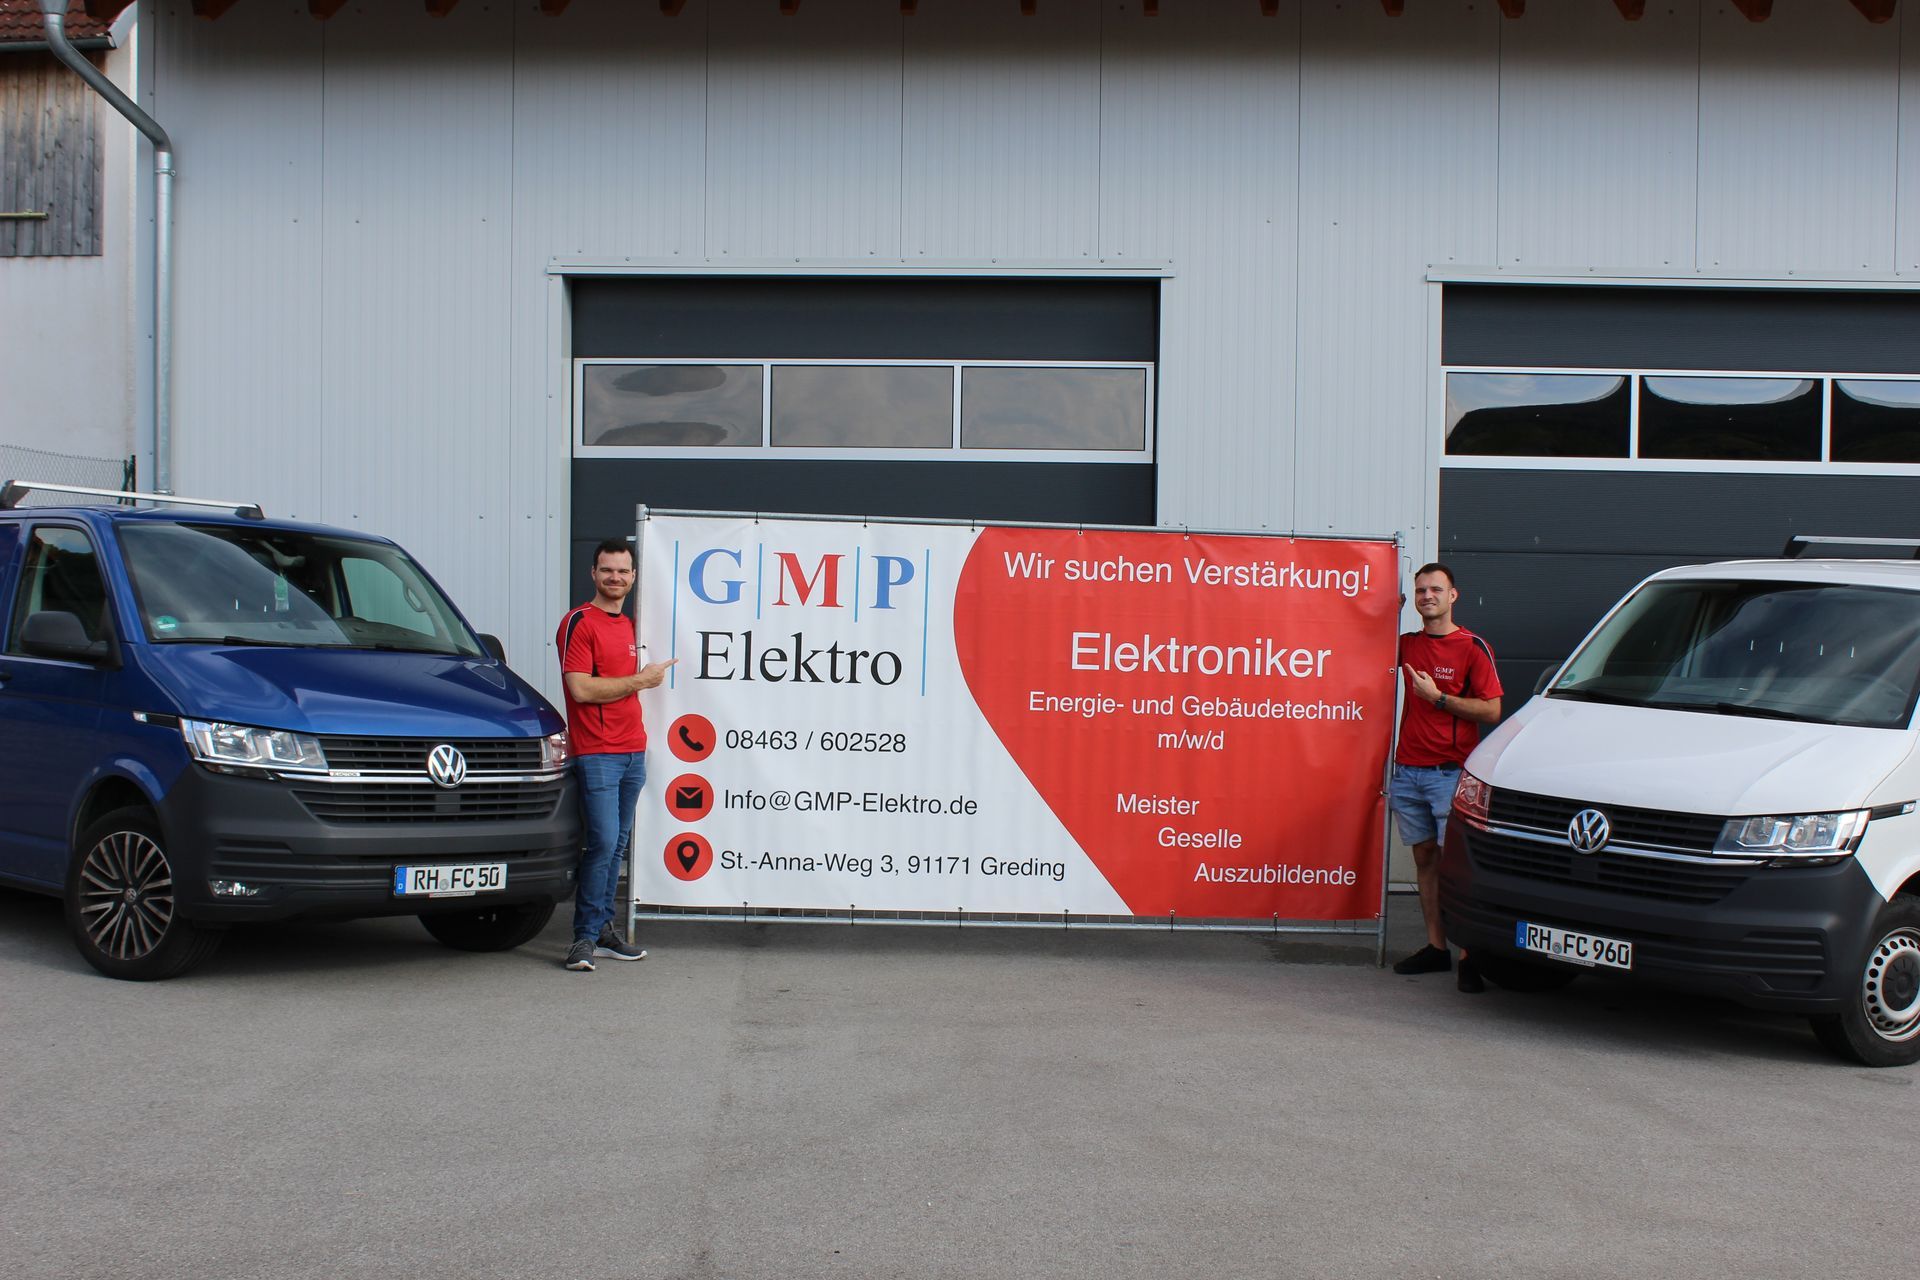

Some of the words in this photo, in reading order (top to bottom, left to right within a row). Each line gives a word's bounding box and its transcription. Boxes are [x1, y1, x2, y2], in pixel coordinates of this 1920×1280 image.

[1003, 551, 1056, 579] Wir
[1064, 555, 1172, 583] suchen
[1183, 557, 1370, 597] Verstärkung!
[694, 630, 902, 686] Elektro
[1071, 631, 1332, 678] Elektroniker
[1029, 690, 1125, 718] Energie-
[1132, 695, 1174, 716] und
[1181, 695, 1363, 721] Gebäudetechnik
[725, 729, 798, 751] 08463
[805, 730, 814, 750] /
[820, 731, 906, 753] 602528
[1157, 730, 1225, 750] m/w/d
[725, 789, 978, 816] Info@GMP-Elektro.de
[1116, 793, 1200, 816] Meister
[1158, 826, 1242, 849] Geselle
[414, 869, 439, 890] RH
[451, 868, 474, 888] FC
[478, 866, 500, 888] 50
[720, 850, 873, 878] St.-Anna-Weg
[880, 854, 899, 876] 3,
[907, 855, 970, 876] 91171
[980, 856, 1066, 882] Greding
[1193, 862, 1356, 886] Auszubildende
[1527, 926, 1552, 951] RH
[1563, 933, 1589, 958] FC
[1592, 939, 1631, 966] 960
